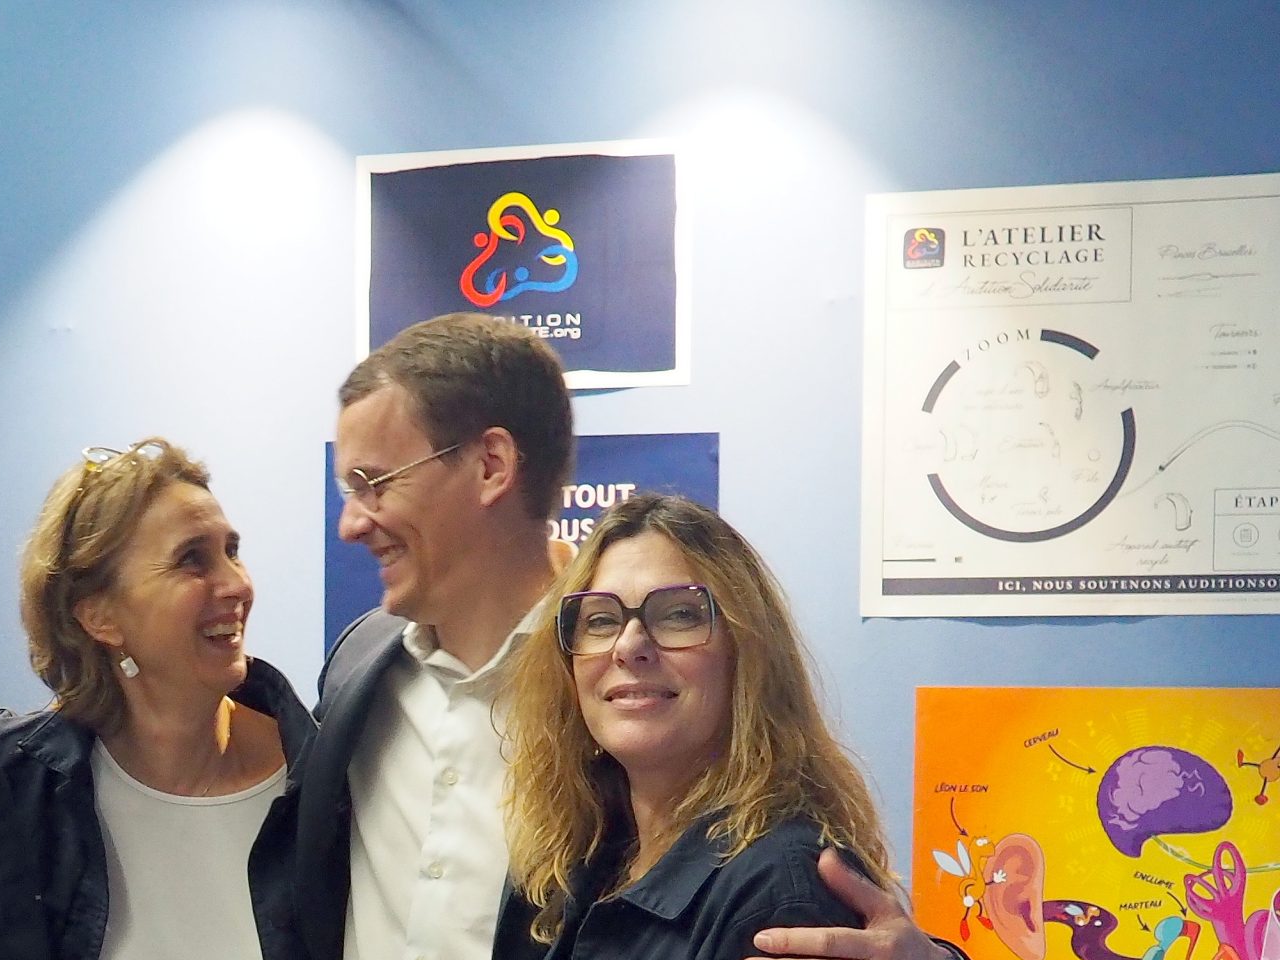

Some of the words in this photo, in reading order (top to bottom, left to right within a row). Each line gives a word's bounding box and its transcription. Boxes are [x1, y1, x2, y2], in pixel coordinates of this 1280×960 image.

[962, 223, 1106, 247] L'ATELIER
[963, 248, 1106, 268] RECYCLAGE
[562, 484, 636, 508] TOUT
[998, 581, 1026, 593] ICI,
[1033, 580, 1074, 591] NOUS
[1078, 578, 1171, 591] SOUTENONS
[1178, 577, 1280, 589] AUDITIONSO
[1023, 728, 1060, 748] CERVEAU
[1119, 900, 1162, 912] MARTEAU
